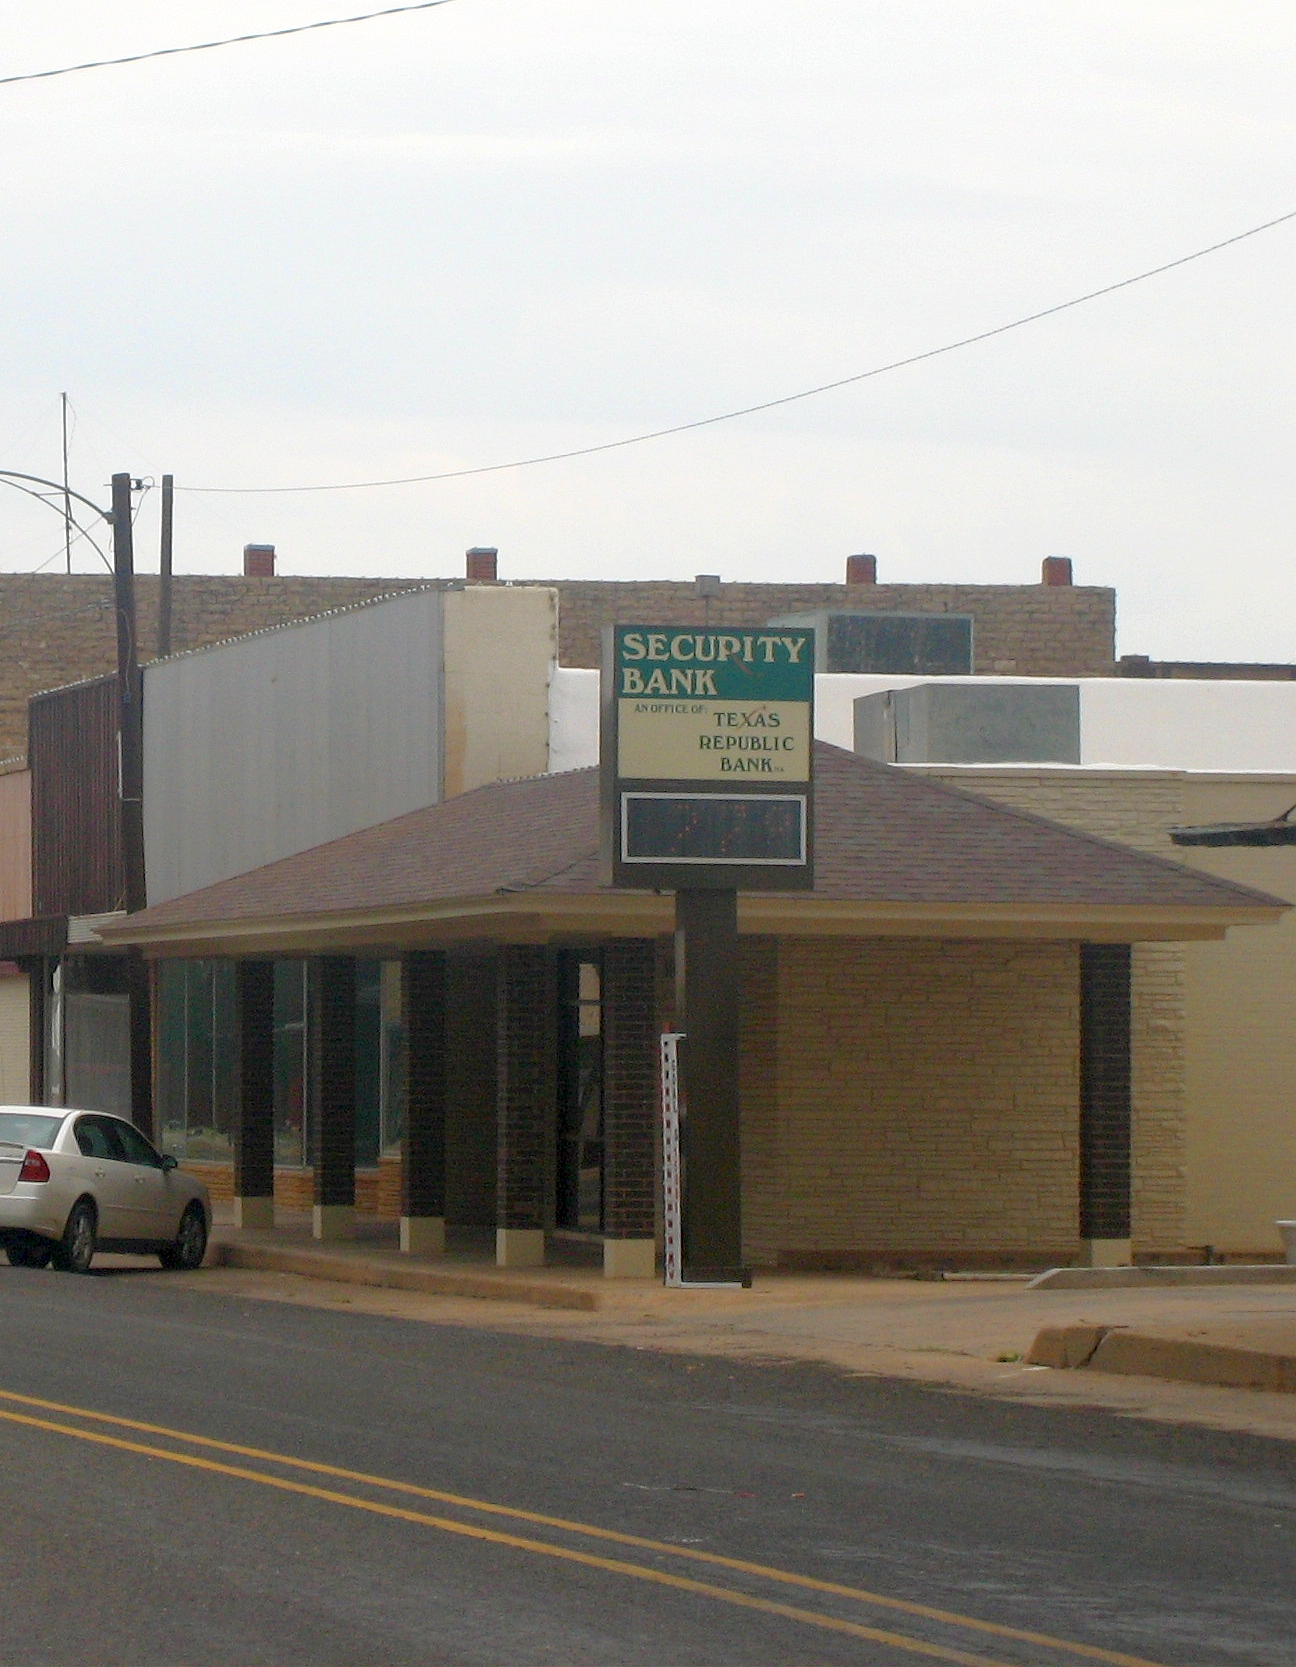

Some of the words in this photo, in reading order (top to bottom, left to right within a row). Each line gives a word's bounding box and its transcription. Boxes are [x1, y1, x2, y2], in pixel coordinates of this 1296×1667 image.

[622, 633, 806, 673] SECURITY
[621, 667, 718, 696] BANK
[634, 703, 648, 713] AN
[650, 703, 688, 714] OFFICE
[713, 709, 781, 728] TEXAS
[699, 735, 795, 751] REPUBLIC
[720, 757, 773, 773] BANK
